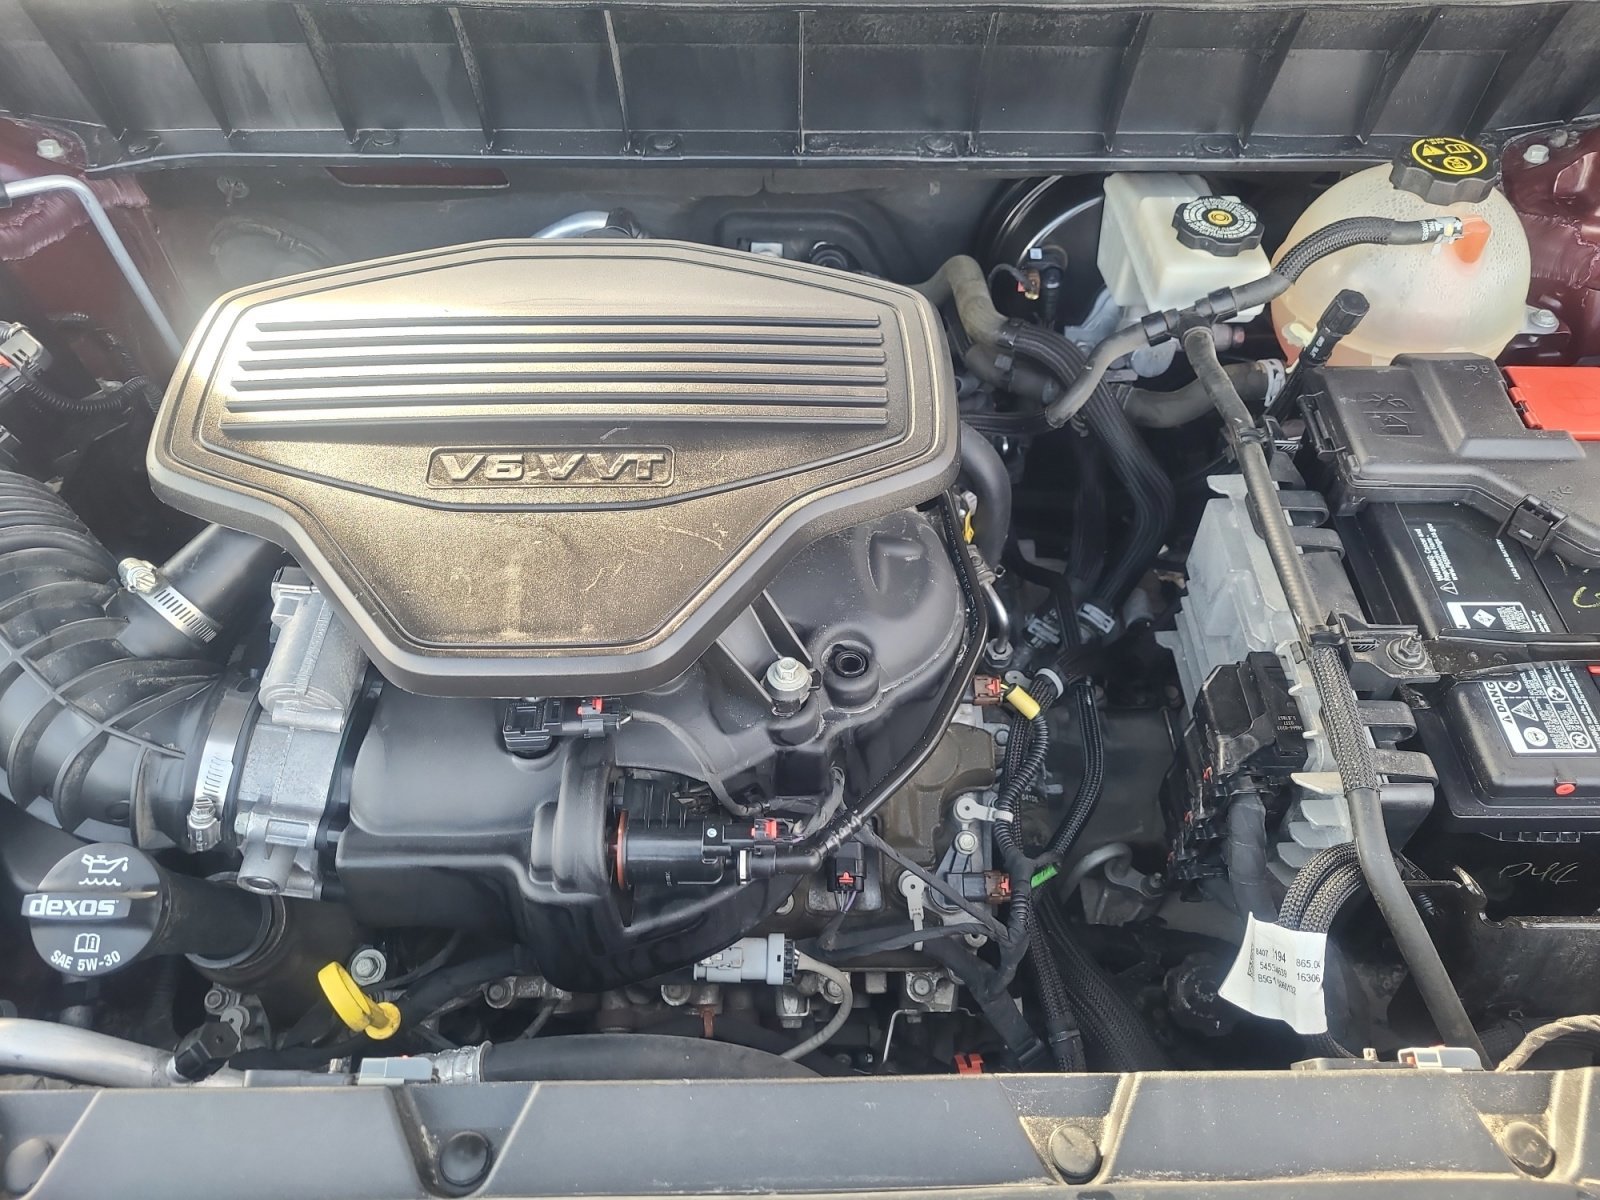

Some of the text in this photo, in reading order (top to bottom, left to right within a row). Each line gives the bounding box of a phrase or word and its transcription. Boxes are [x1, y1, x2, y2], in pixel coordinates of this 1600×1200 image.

[440, 453, 664, 481] V6 VVT
[29, 895, 115, 916] dexos
[51, 950, 121, 971] SAE 5W-30
